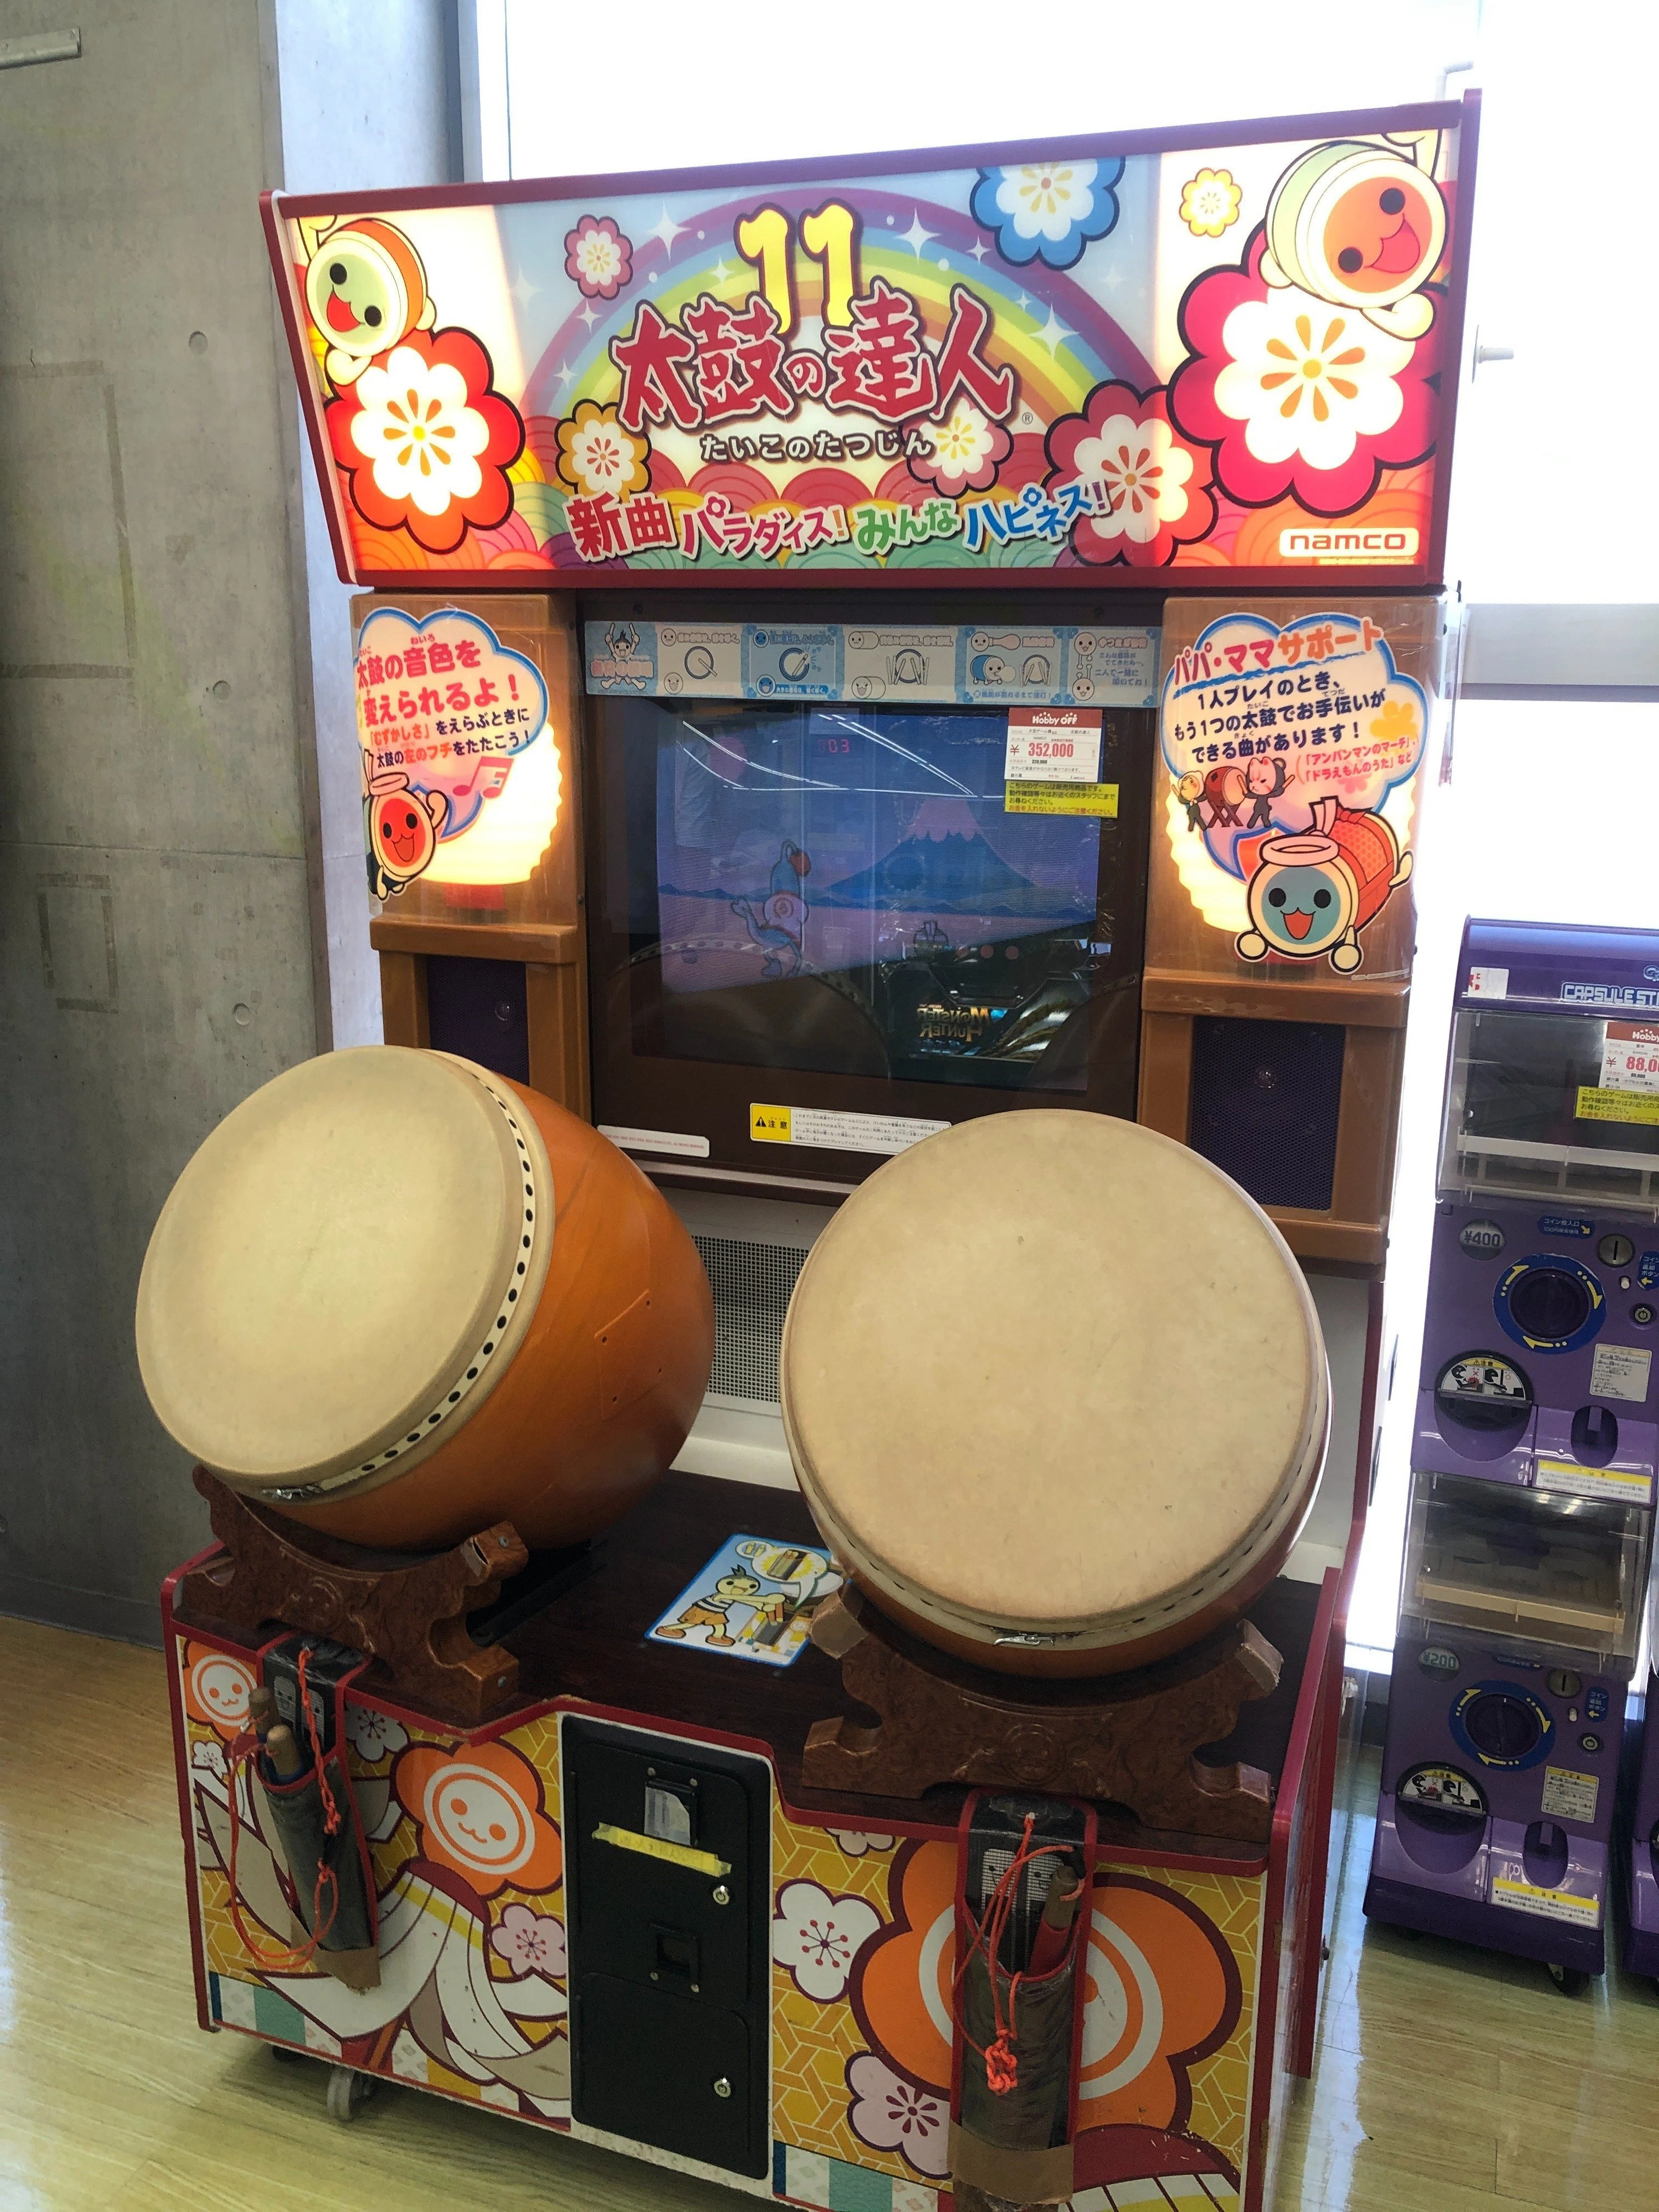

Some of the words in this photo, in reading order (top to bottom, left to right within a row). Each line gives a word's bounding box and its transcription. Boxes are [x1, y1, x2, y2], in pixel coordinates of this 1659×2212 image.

[738, 203, 862, 335] 11
[611, 277, 1016, 433] 太鼓の達人
[699, 432, 935, 463] たいこのたつじん
[1290, 533, 1406, 550] namco
[357, 640, 482, 690] 太鼓の音色を
[363, 674, 520, 728] 変えられるよ！
[1032, 713, 1059, 725] Hobby
[1060, 713, 1077, 725] OFF
[1175, 687, 1386, 741] もう1つの太鼓でお手伝いが
[1028, 742, 1074, 758] 352,000
[1192, 722, 1359, 763] できる曲があります！
[1564, 984, 1634, 1004] CAPSULE
[1626, 1056, 1659, 1073] 88,0
[768, 1119, 788, 1129] 注意
[1464, 1231, 1500, 1246] ¥400
